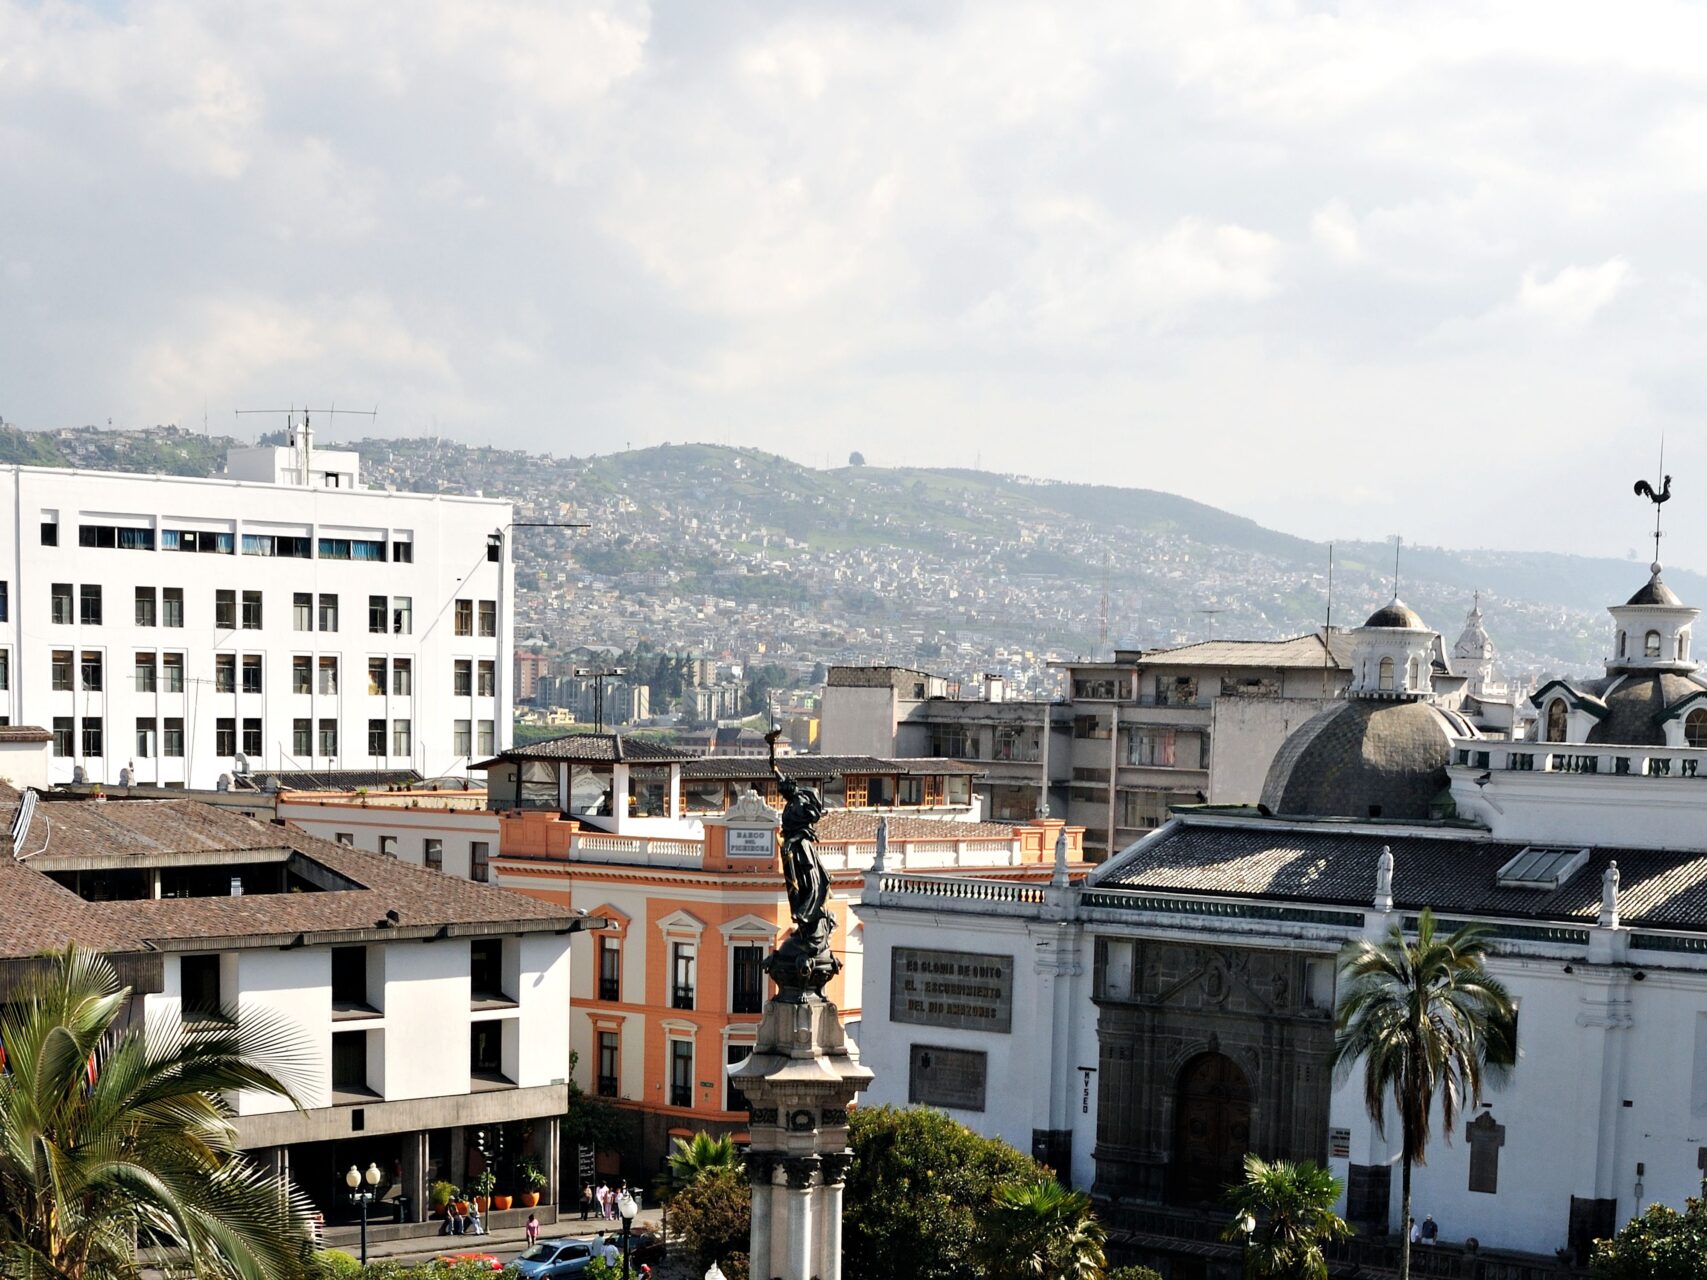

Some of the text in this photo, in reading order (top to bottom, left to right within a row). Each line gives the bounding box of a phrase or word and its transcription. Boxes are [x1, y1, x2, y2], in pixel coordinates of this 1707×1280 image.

[906, 960, 1002, 979] ES GLORIA DE QUITO
[905, 979, 917, 992] EL
[908, 999, 925, 1012] DEL
[946, 1003, 997, 1019] AMAZONAS
